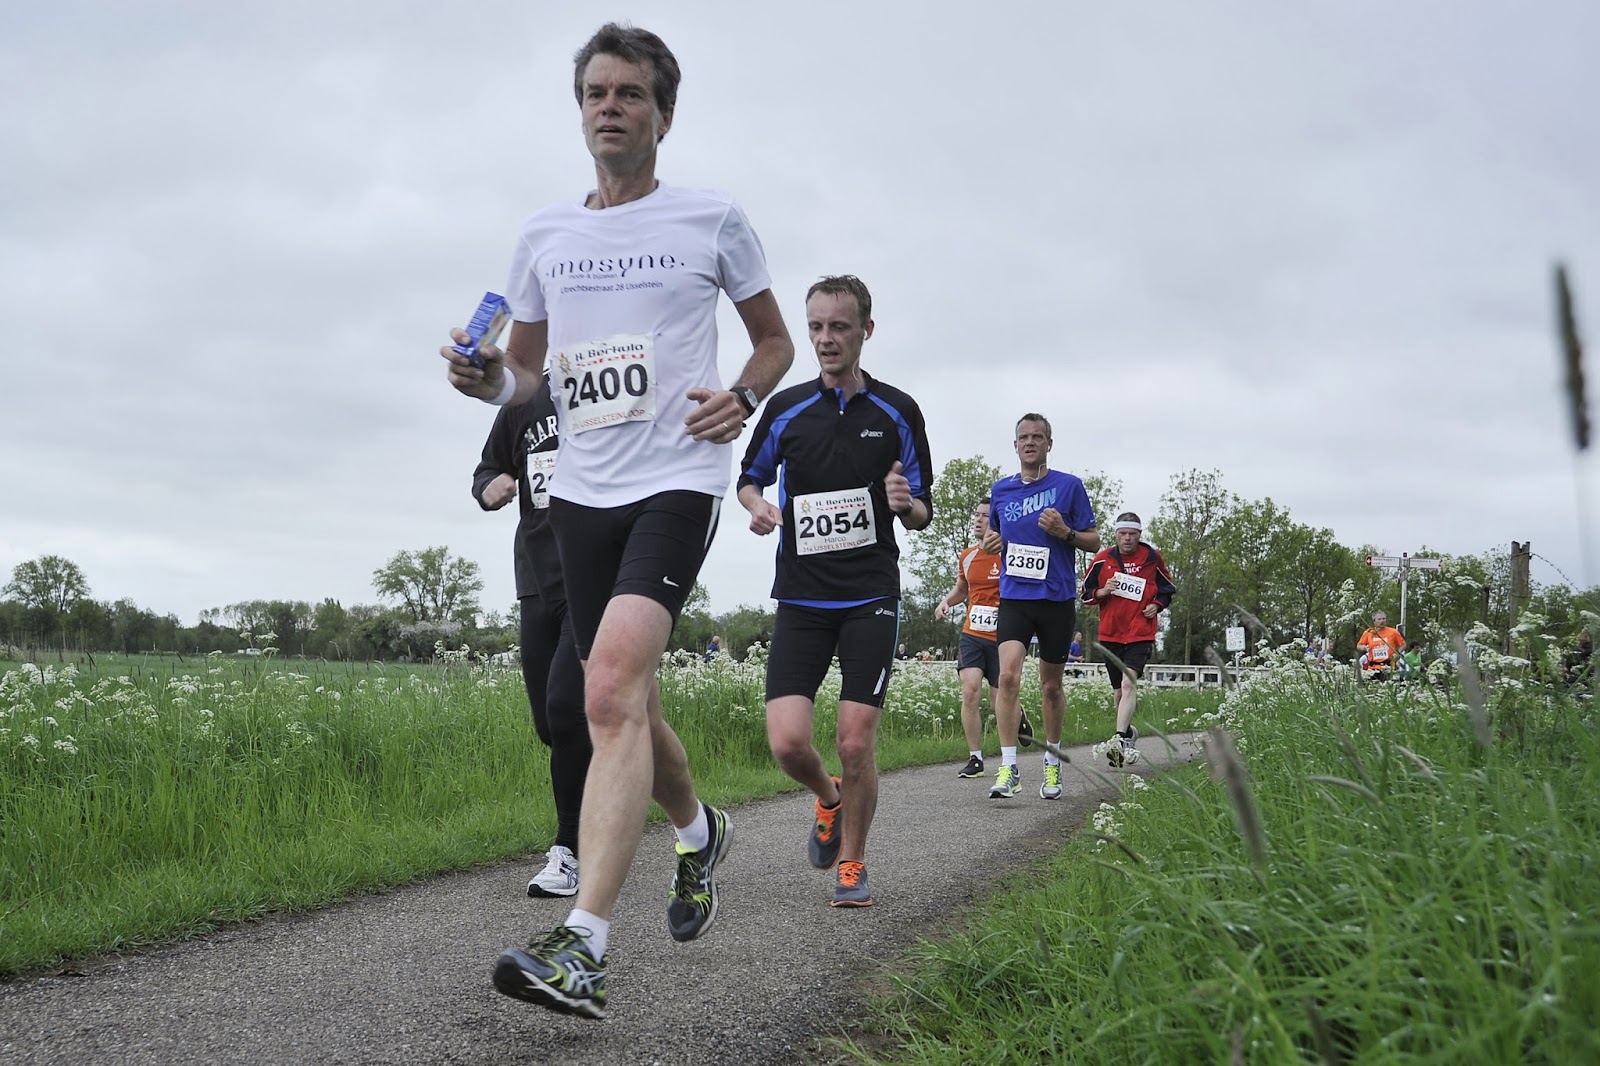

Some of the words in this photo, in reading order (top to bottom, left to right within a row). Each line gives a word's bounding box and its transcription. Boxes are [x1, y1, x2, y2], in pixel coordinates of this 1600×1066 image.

[564, 363, 648, 410] 2400
[1022, 487, 1057, 516] RUN
[799, 508, 870, 539] 2054
[1008, 554, 1045, 571] 2380
[1115, 581, 1141, 595] 2066
[971, 613, 998, 626] 2147
